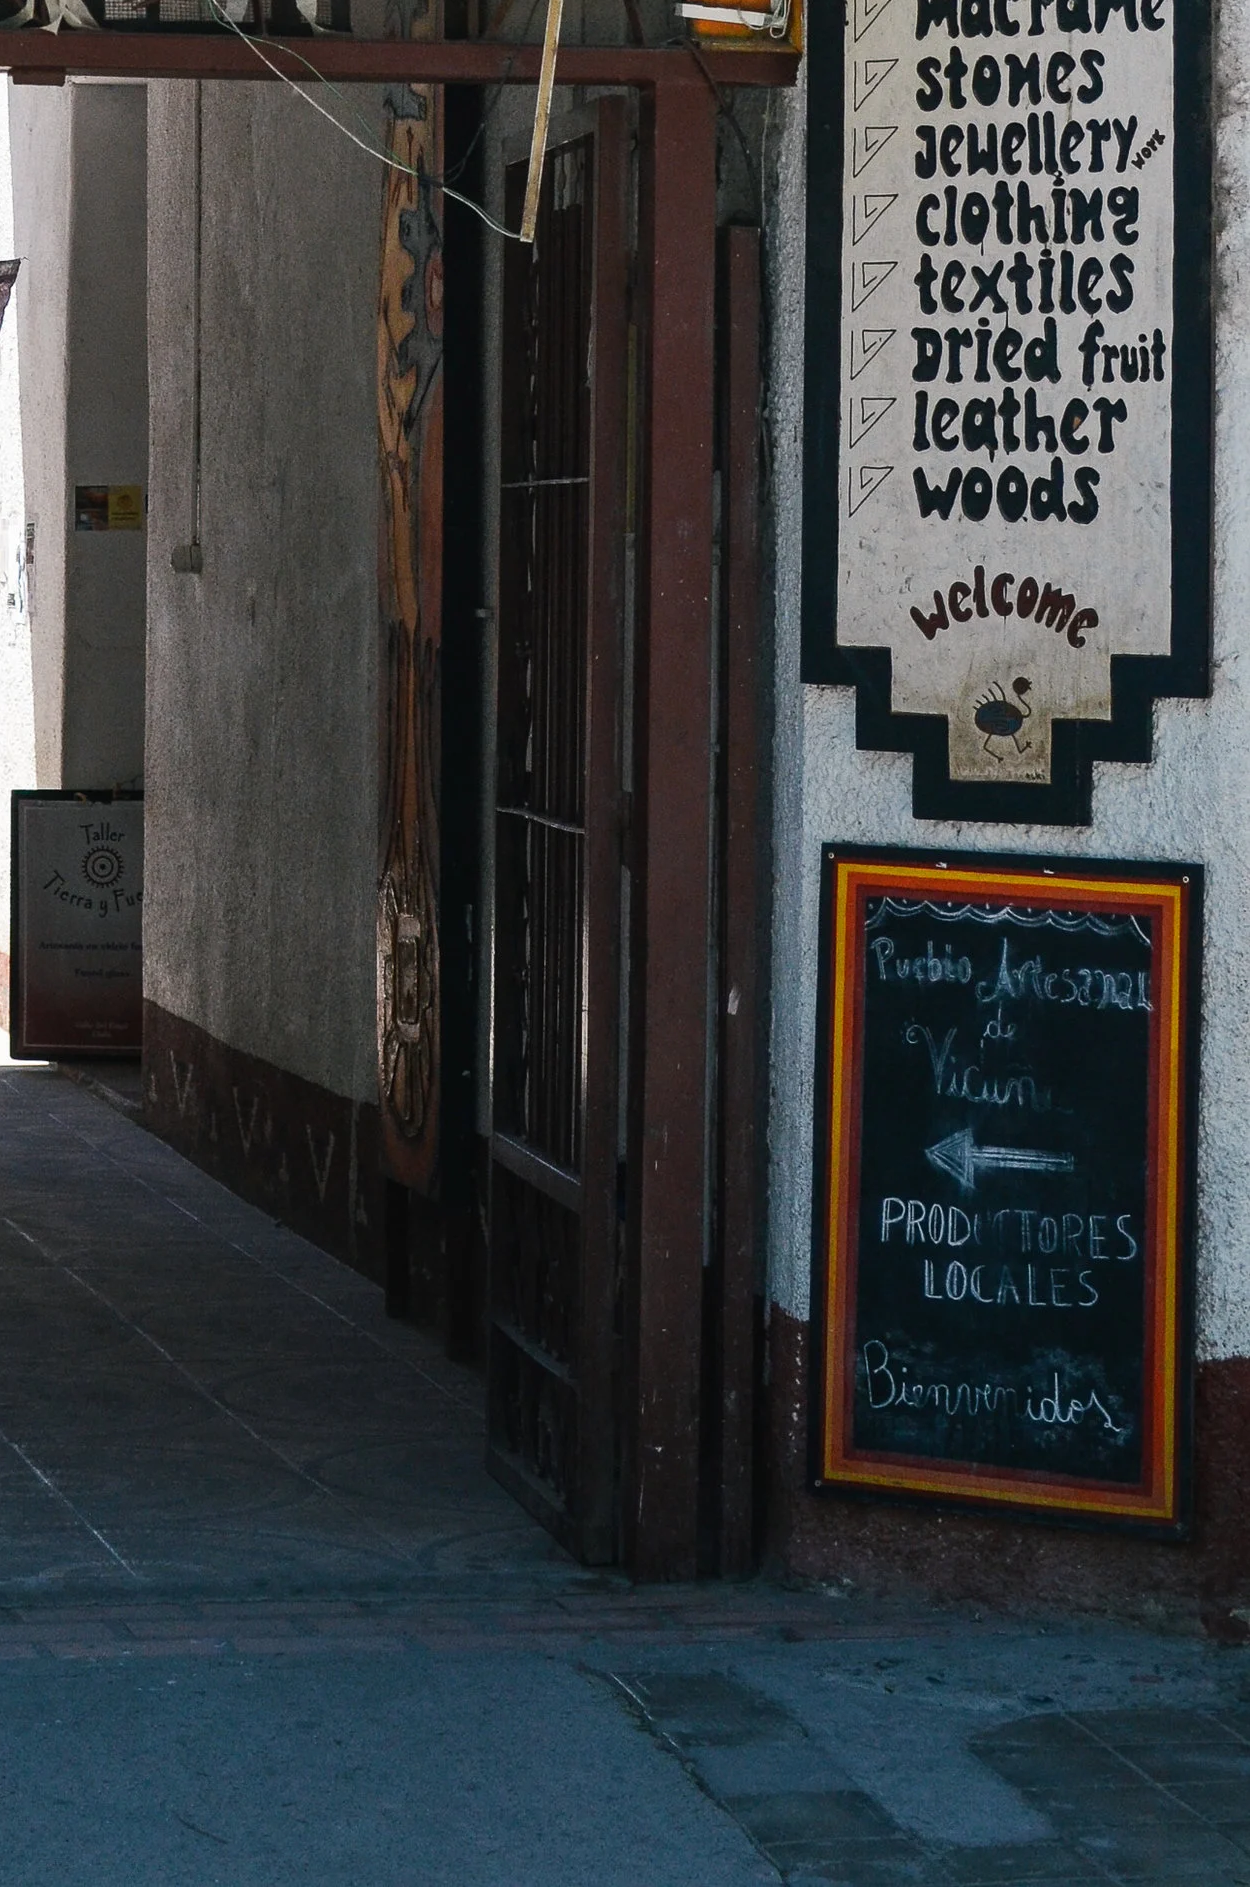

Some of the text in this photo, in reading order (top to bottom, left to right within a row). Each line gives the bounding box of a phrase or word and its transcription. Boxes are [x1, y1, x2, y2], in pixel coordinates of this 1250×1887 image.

[915, 46, 1106, 112] stones
[916, 173, 1140, 247] clothing
[914, 248, 1135, 316] textiles
[1078, 319, 1167, 387] fruit
[913, 387, 1128, 456] leather
[913, 456, 1101, 525] woods
[910, 565, 1099, 649] welcome
[80, 822, 126, 845] Taller
[43, 870, 93, 910] Tierra
[99, 899, 108, 918] y
[924, 1260, 1100, 1306] LOCALES
